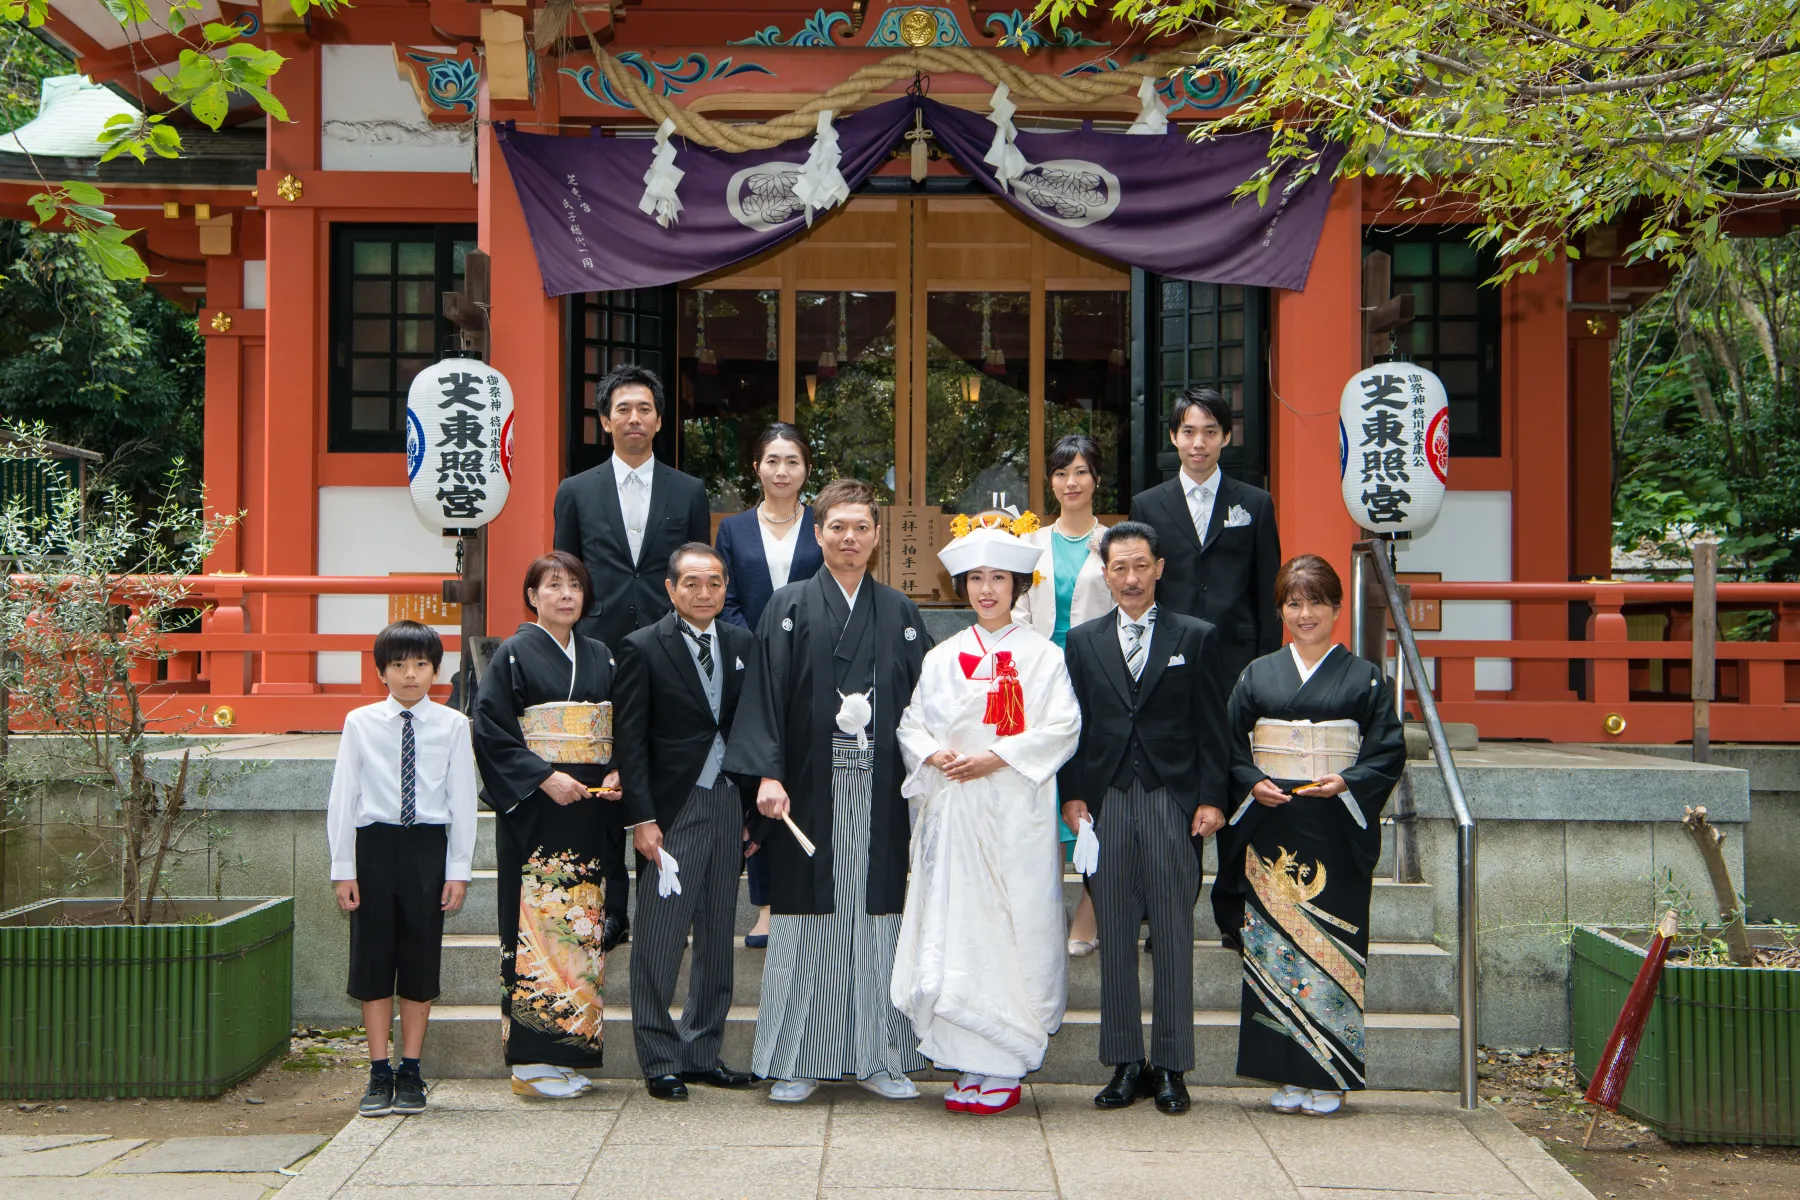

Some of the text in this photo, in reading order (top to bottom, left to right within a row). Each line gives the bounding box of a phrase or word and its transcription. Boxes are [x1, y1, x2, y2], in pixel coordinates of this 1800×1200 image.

[562, 198, 594, 269] 氏子総代一同
[434, 371, 488, 519] 芝東照宮
[486, 374, 502, 475] 御祭神 徳川家康公
[1359, 373, 1412, 524] 芝東照宮
[1407, 373, 1427, 468] 御祭神 徳川家康公
[901, 510, 919, 592] 二拝二拍手一拝
